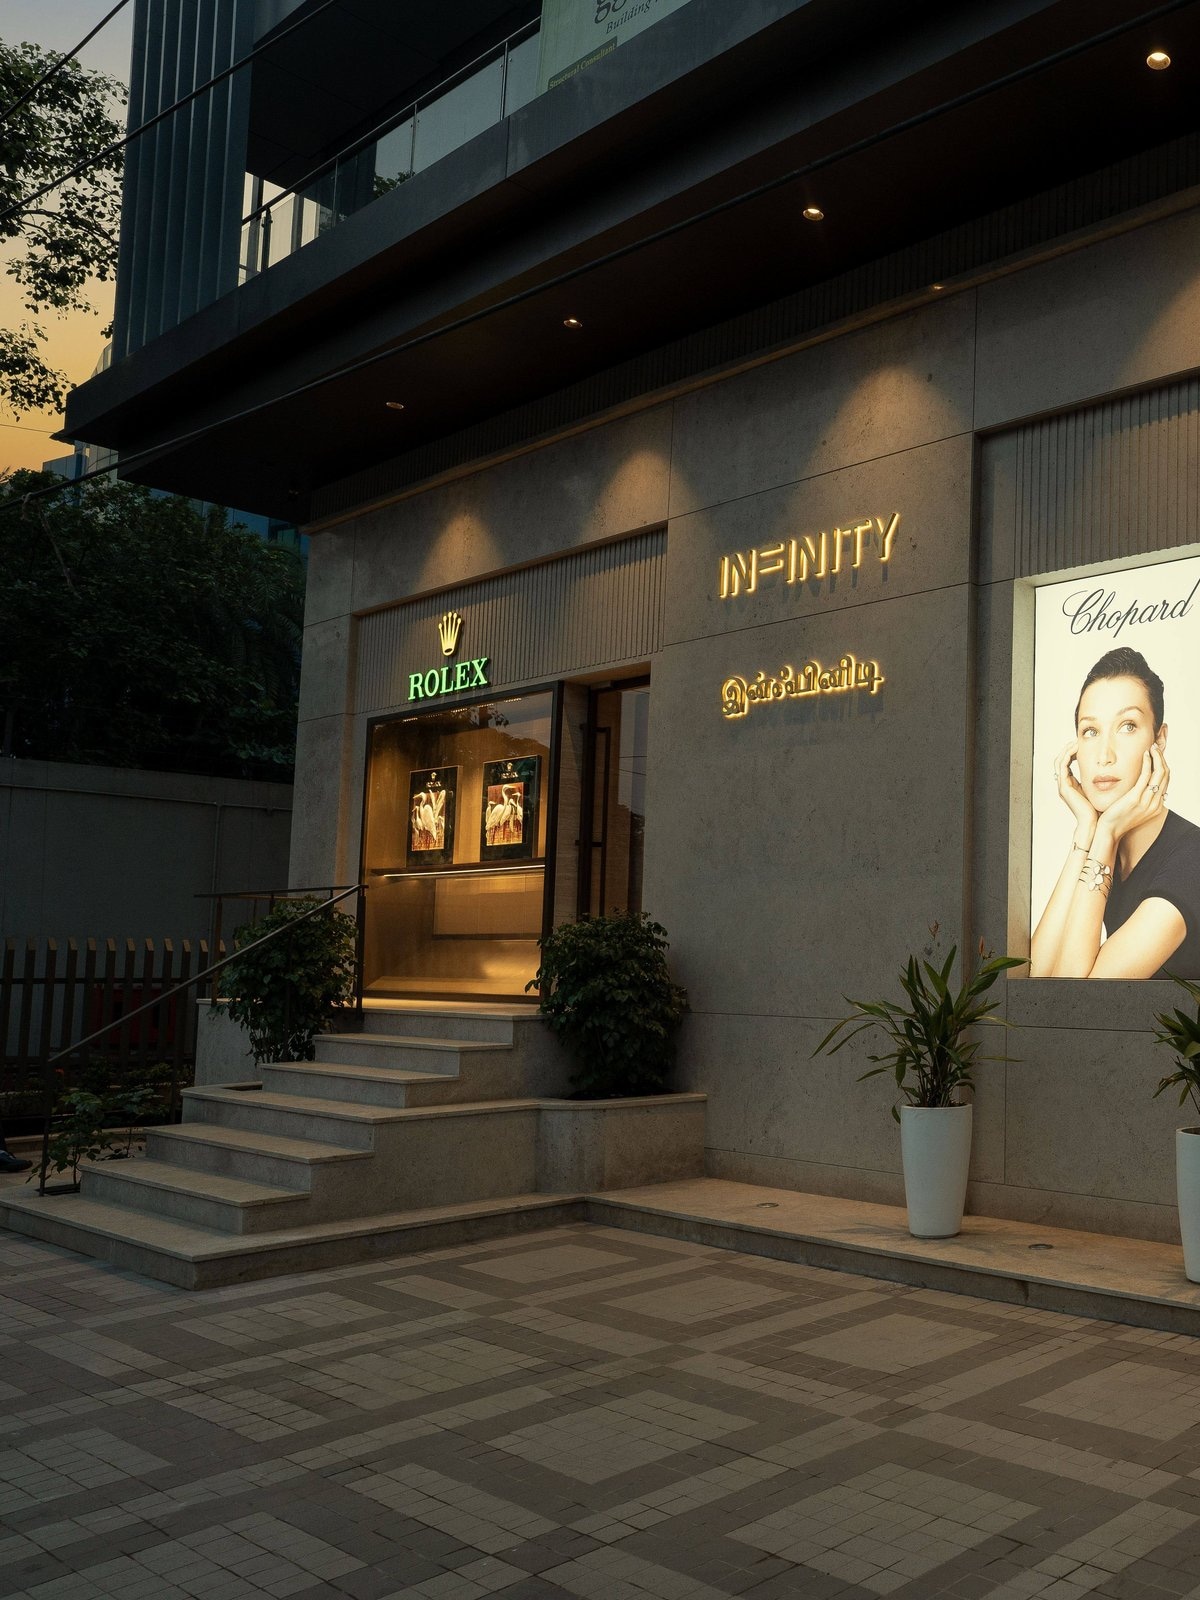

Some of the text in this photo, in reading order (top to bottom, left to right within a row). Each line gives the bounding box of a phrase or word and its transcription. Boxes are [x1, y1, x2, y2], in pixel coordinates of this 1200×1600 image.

[606, 0, 651, 34] Building
[719, 512, 899, 599] INFINITY
[408, 657, 489, 701] ROLEX
